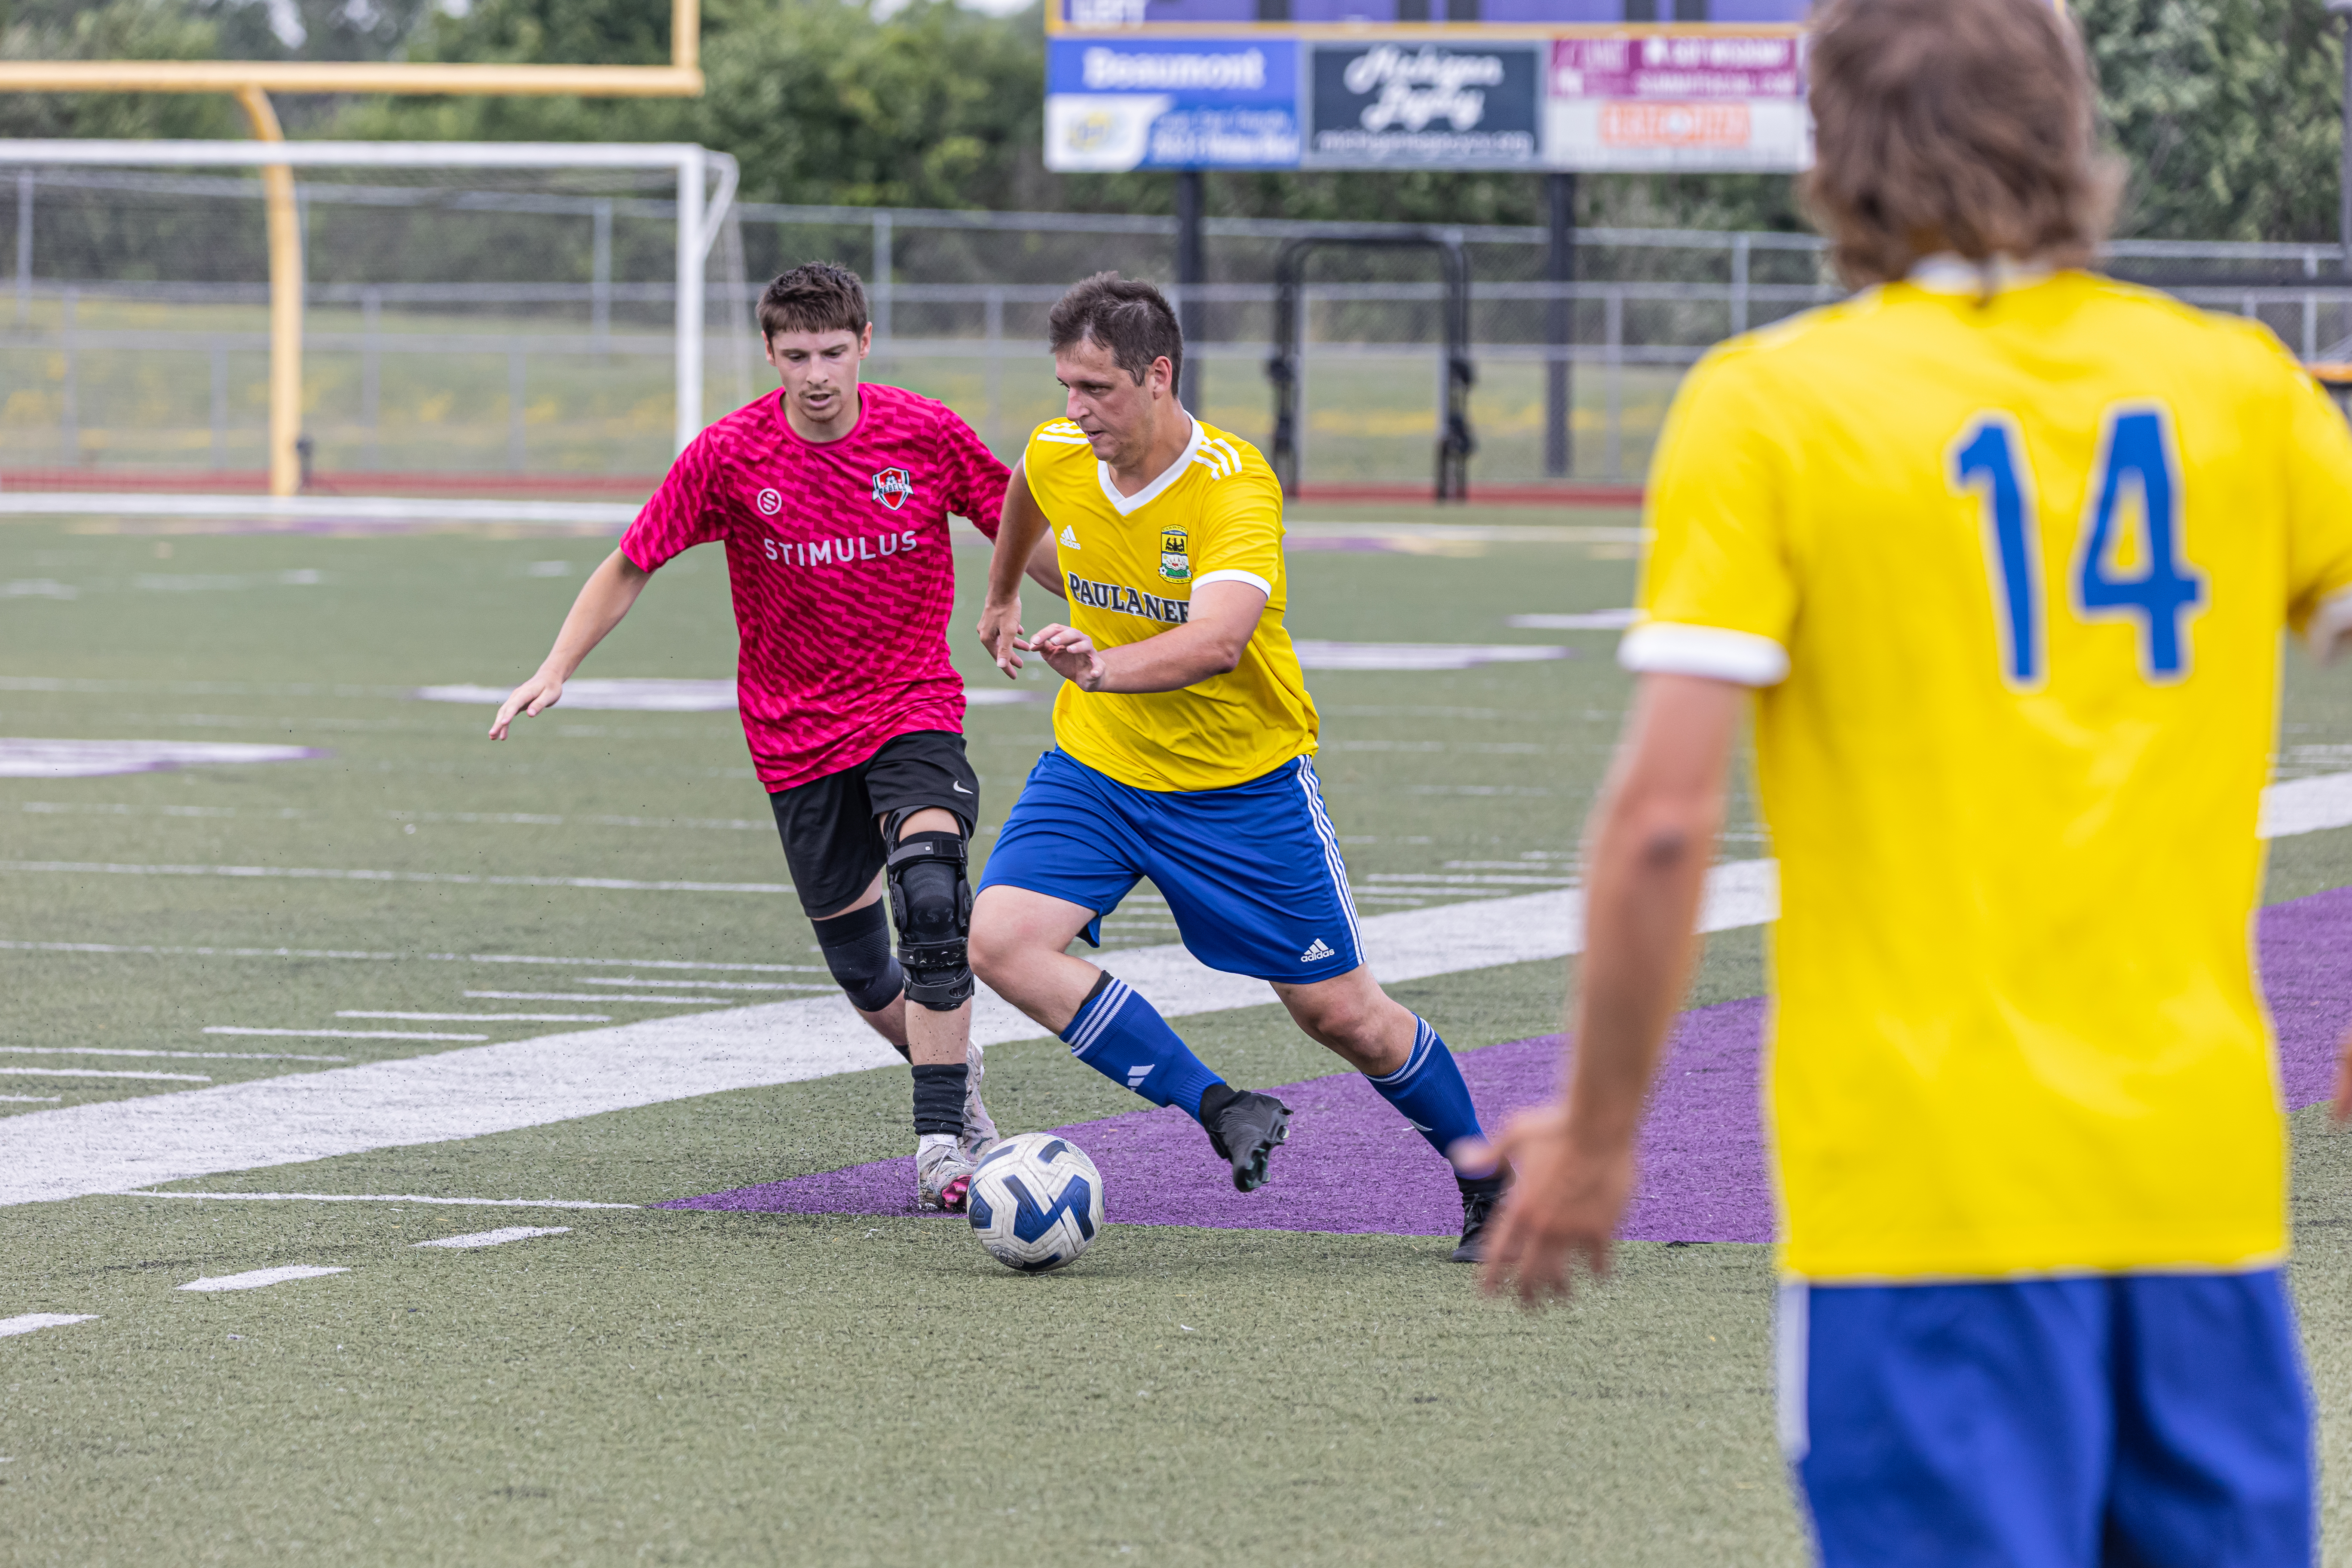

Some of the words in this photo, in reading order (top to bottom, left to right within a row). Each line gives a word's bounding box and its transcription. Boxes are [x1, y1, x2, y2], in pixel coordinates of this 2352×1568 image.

[1084, 48, 1264, 89] Beaumont
[879, 484, 906, 496] REBELS
[763, 530, 917, 567] STIMULUS
[1059, 537, 1081, 550] adidas
[1946, 403, 2206, 689] 14
[1301, 949, 1335, 962] adidas
